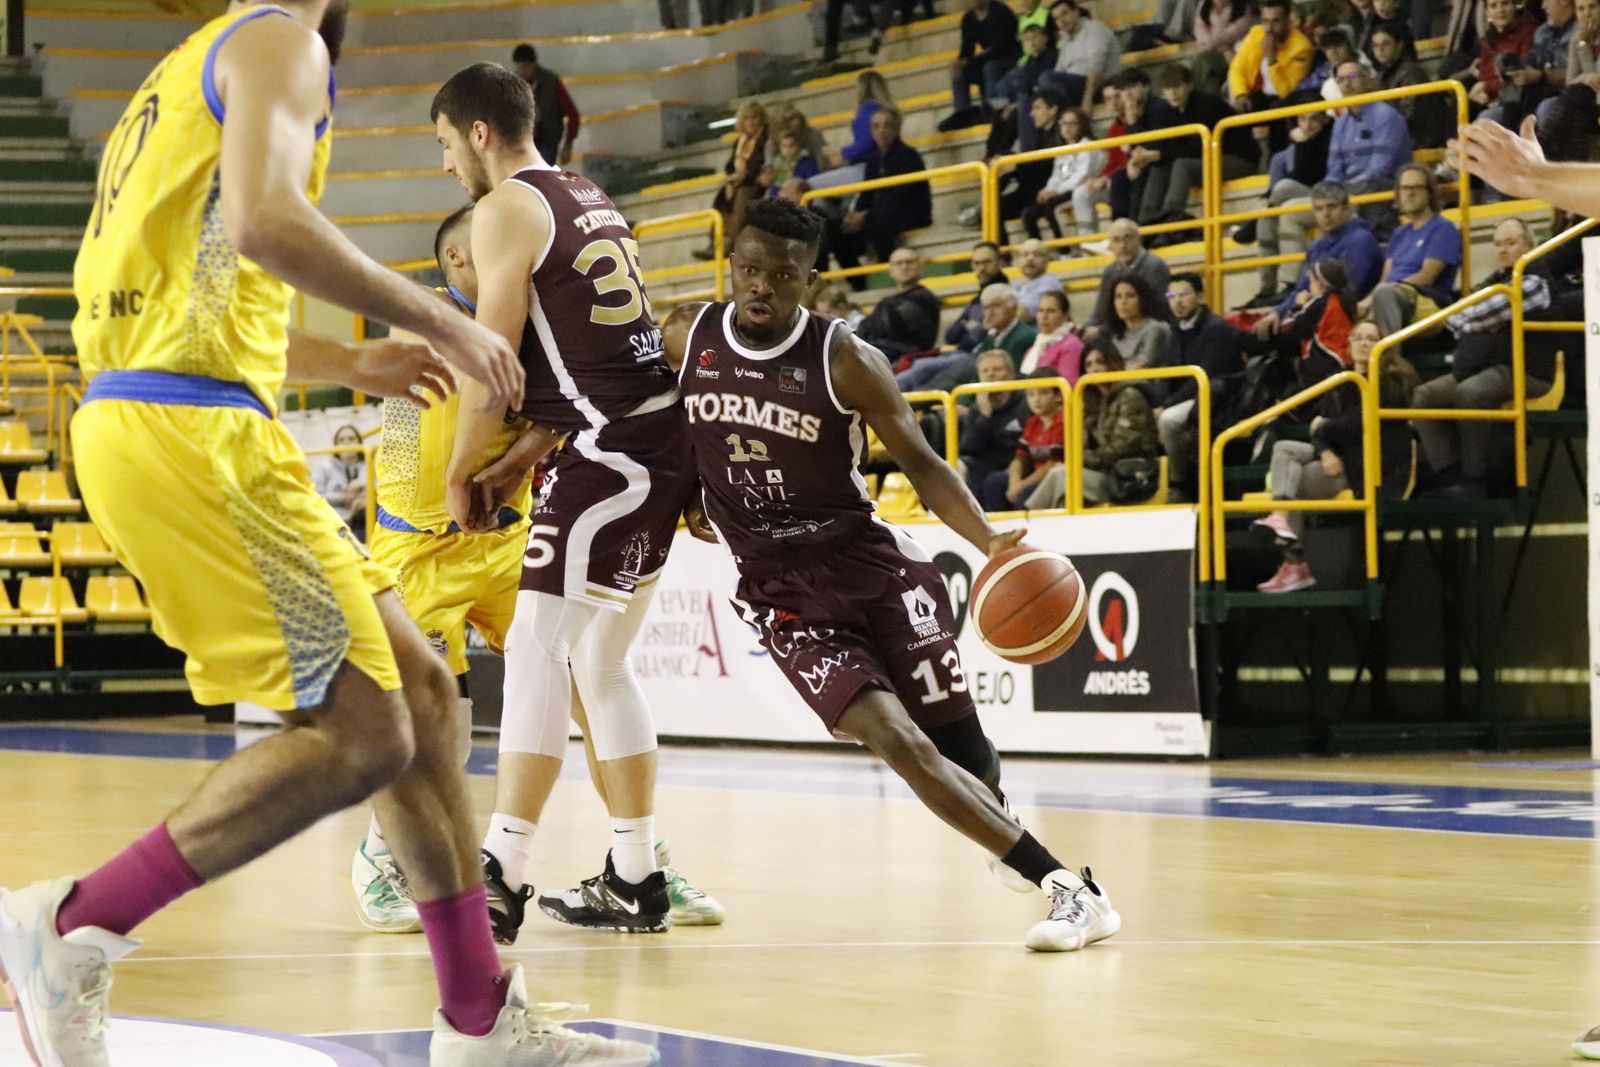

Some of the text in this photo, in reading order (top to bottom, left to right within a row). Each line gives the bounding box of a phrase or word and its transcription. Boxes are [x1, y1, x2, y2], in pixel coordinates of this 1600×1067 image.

[684, 392, 821, 443] TORMES
[726, 467, 757, 485] LA
[911, 649, 968, 705] 13
[1083, 669, 1151, 695] ANDRÉS
